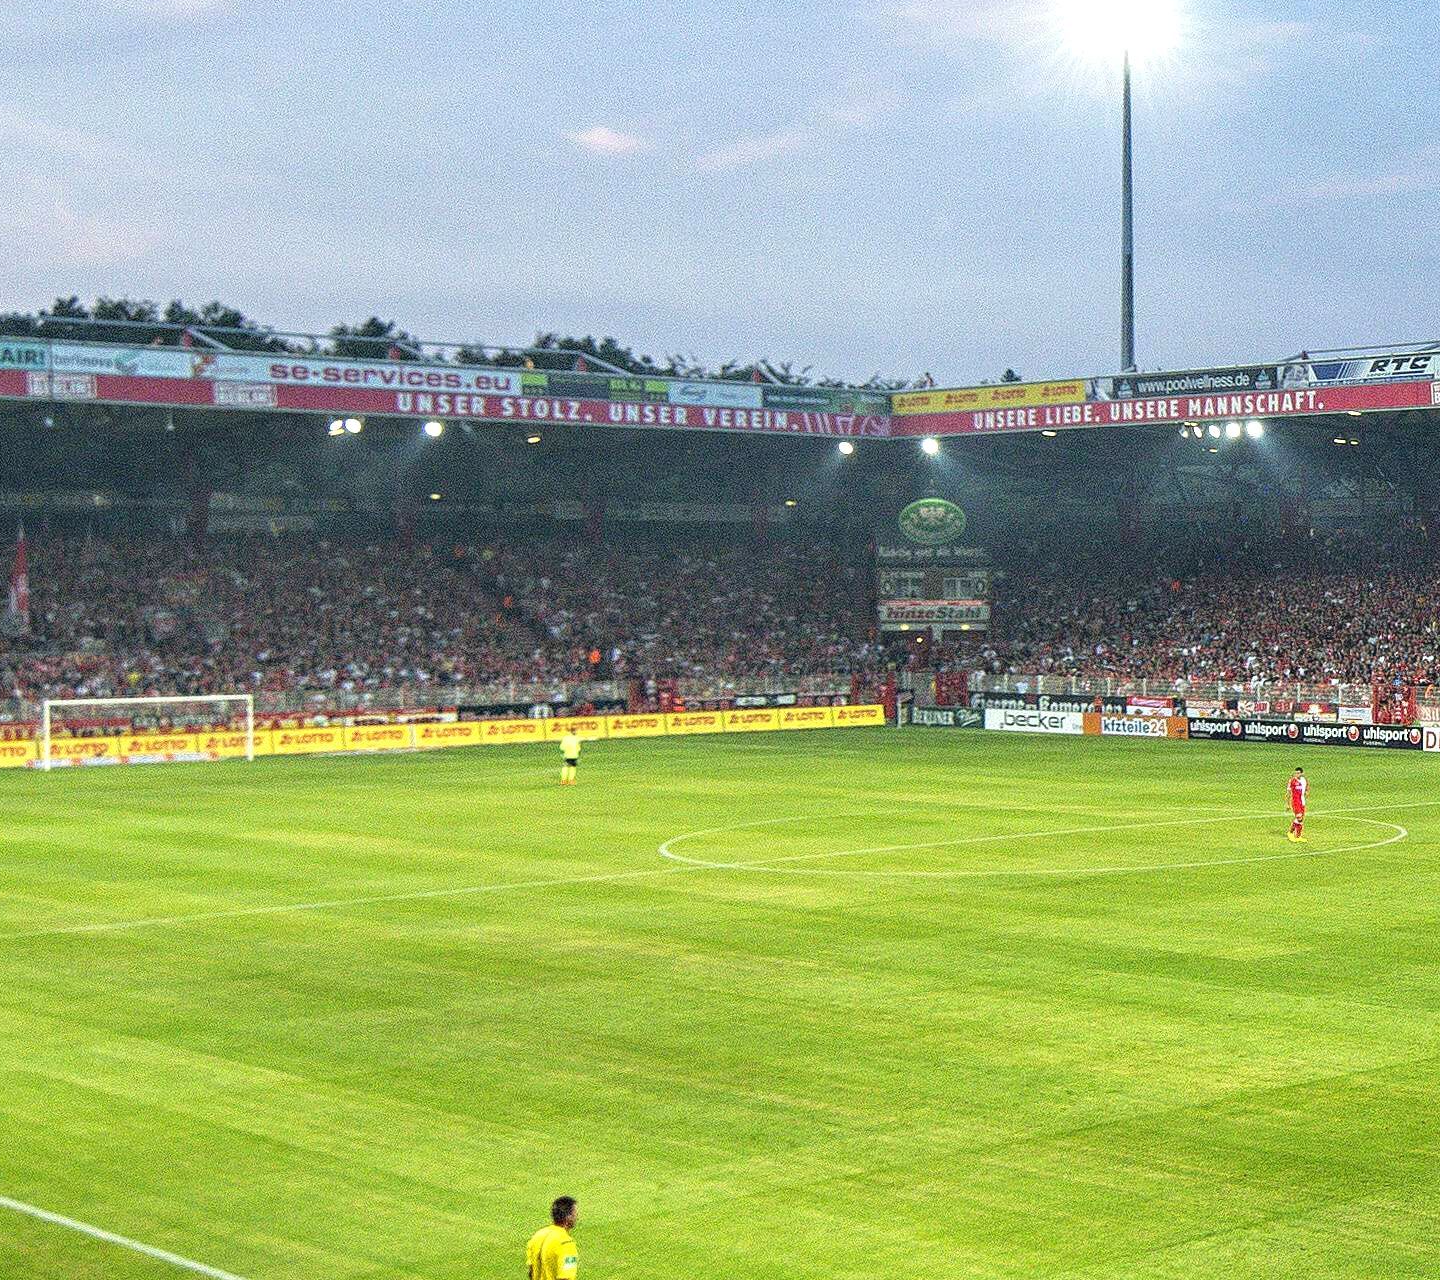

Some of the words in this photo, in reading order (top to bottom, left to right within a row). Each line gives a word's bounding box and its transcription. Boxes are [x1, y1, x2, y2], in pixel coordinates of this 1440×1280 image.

[1370, 356, 1431, 373] RTC
[270, 362, 512, 391] se-services.eu
[1138, 372, 1250, 394] www.poolwellness.de
[397, 393, 485, 415] UNSER
[502, 397, 592, 421] STOLZ.
[609, 403, 688, 425] UNSER
[704, 407, 798, 431] VEREIN.
[974, 408, 1036, 430] UNSERE
[1046, 405, 1100, 424] LIEBE.
[1110, 400, 1178, 421] UNSERE
[1188, 391, 1324, 417] MANNSCHAFT.
[1004, 710, 1066, 731] becker
[1103, 719, 1166, 735] kfzteile24
[1191, 720, 1230, 734] uhlsport
[1245, 723, 1287, 737] uhlsport
[1304, 725, 1347, 740] uhlsport
[1364, 728, 1408, 743] uhlsport
[66, 743, 109, 755] LOTTO
[146, 739, 188, 751] LOTTO
